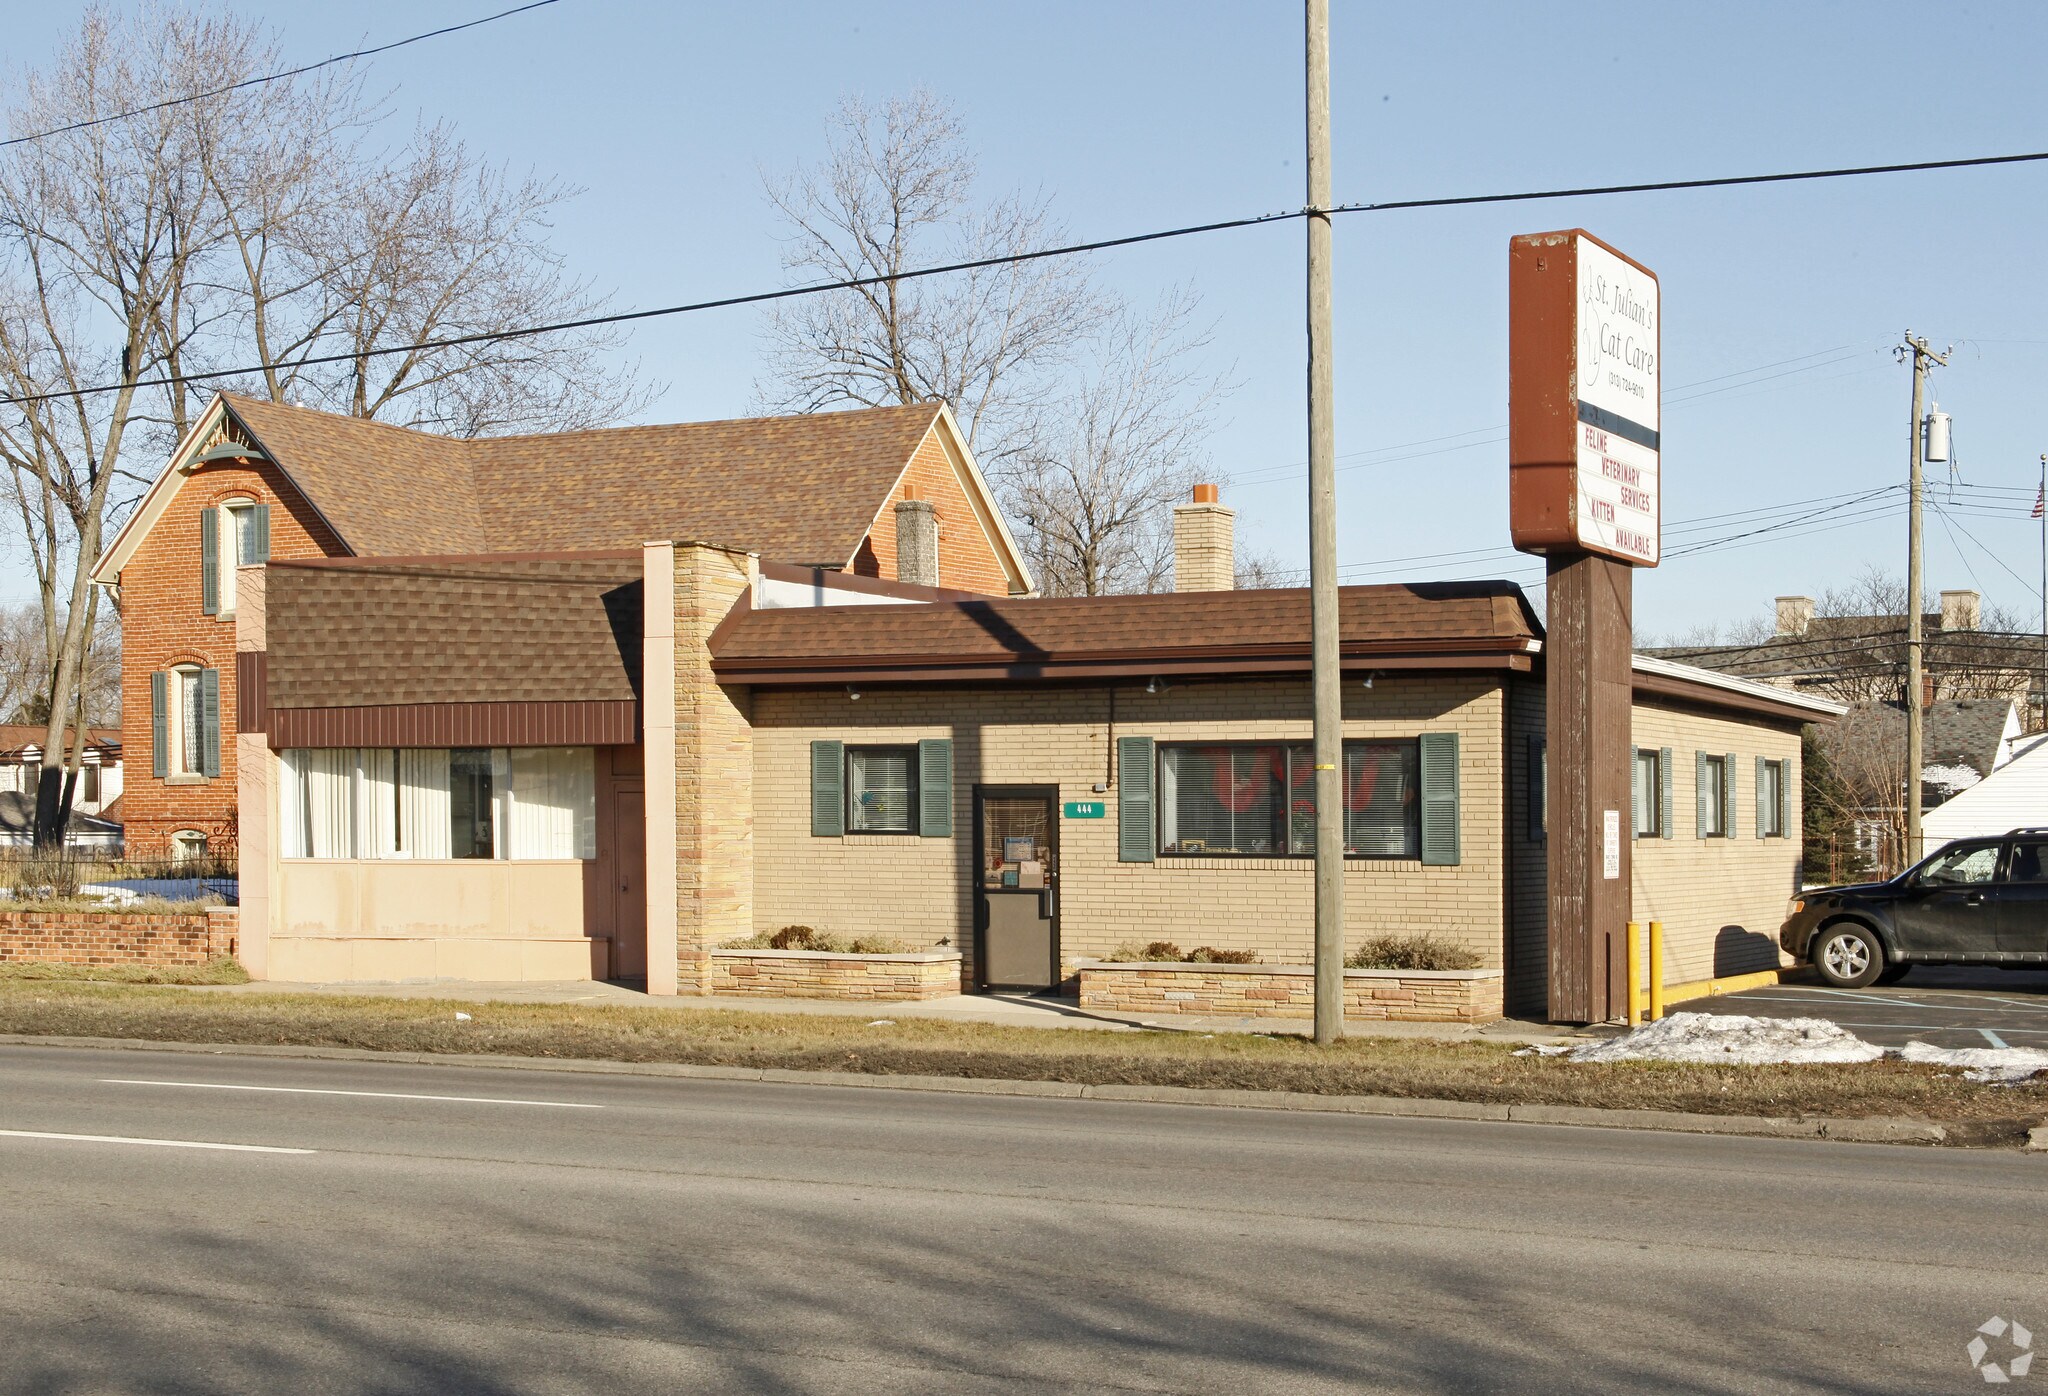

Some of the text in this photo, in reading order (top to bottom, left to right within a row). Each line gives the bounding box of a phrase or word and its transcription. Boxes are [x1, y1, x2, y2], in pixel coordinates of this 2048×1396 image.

[1595, 275, 1653, 330] St. Julian's
[1600, 322, 1654, 375] Cat Care
[1585, 427, 1608, 453] FELINE
[1601, 456, 1640, 488] VETERINARY
[1591, 498, 1615, 523] KITTEN
[1620, 486, 1650, 513] SERVICES
[1615, 528, 1650, 556] AVAILABLE
[1076, 804, 1092, 814] 444
